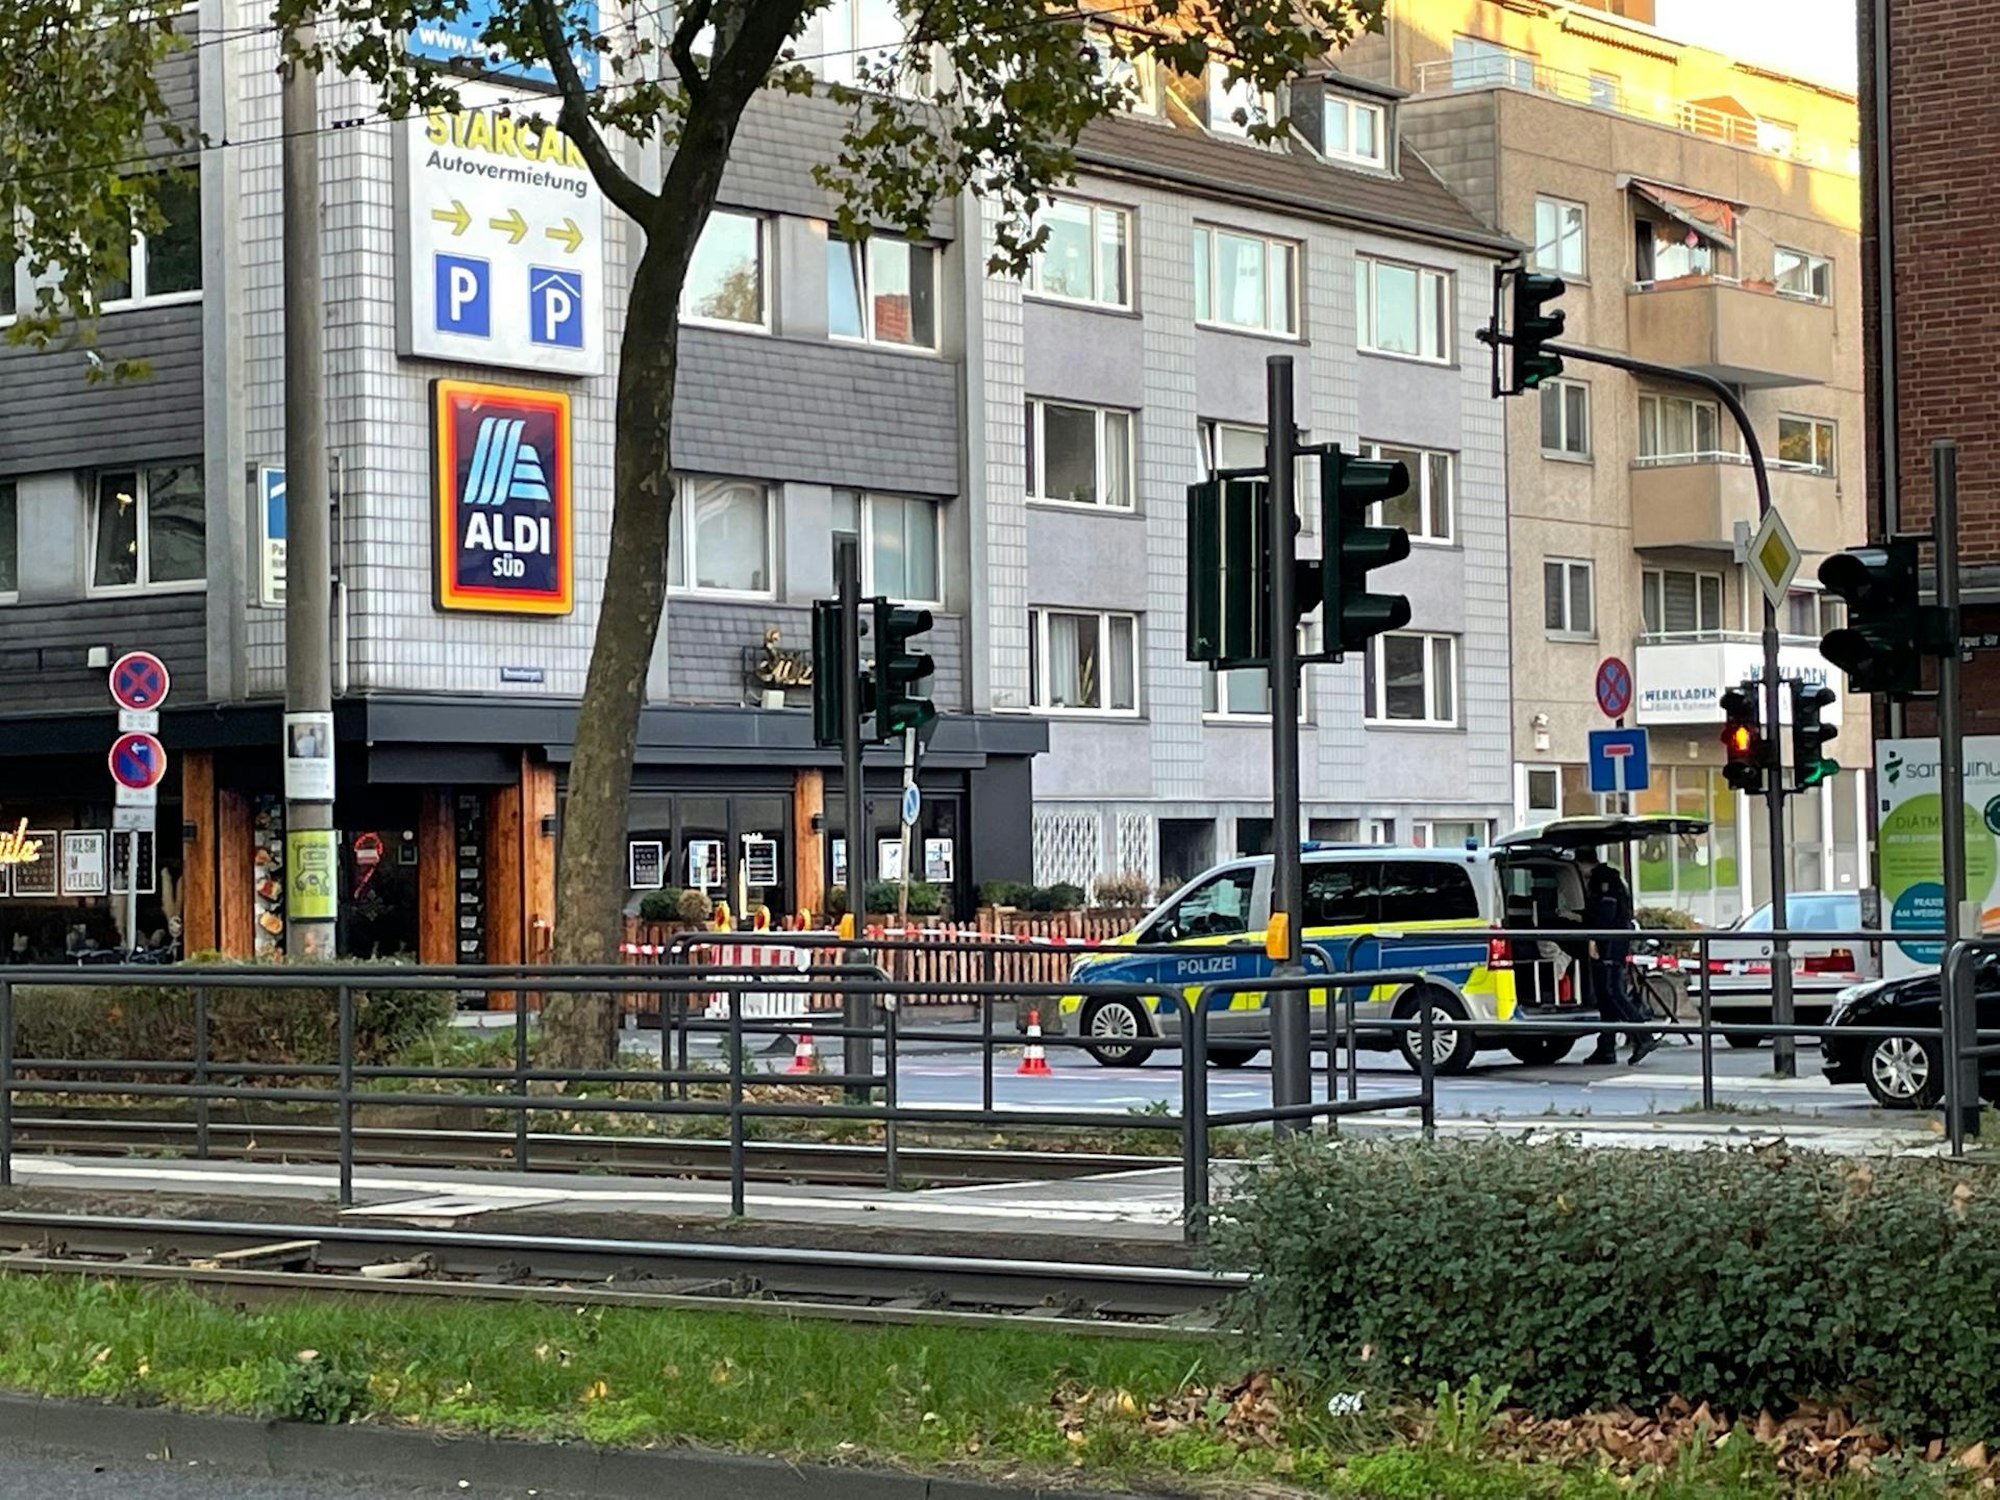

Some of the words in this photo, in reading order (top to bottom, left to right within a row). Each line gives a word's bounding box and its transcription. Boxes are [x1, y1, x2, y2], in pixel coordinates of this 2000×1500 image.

[426, 150, 588, 198] Autovermietung
[451, 266, 477, 321] P
[546, 287, 571, 340] P
[464, 511, 550, 554] ALDI
[492, 553, 525, 578] SÜD
[1644, 687, 1717, 701] WERKLADEN
[1177, 956, 1237, 975] POLIZEI
